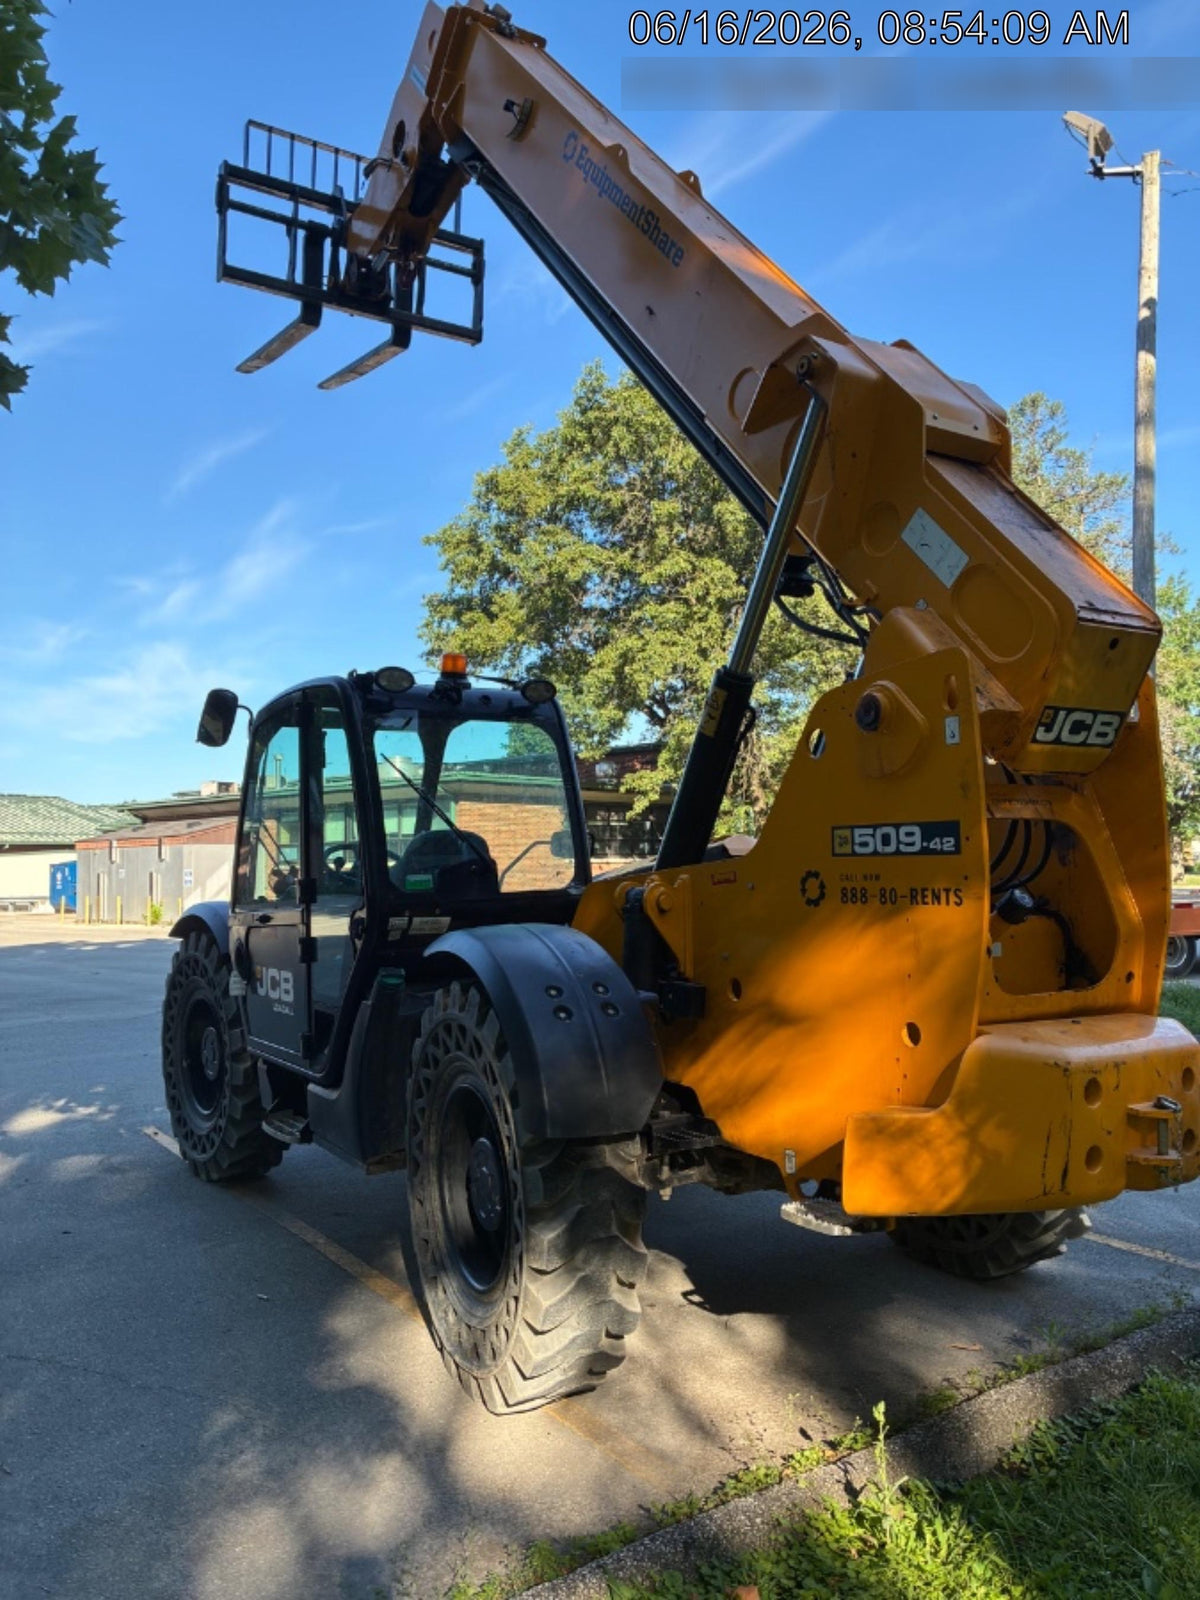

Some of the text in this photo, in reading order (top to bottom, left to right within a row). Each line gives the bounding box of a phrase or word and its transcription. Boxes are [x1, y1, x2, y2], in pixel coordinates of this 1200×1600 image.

[575, 143, 684, 268] EquipmentShare
[1035, 709, 1121, 746] JCB
[853, 824, 957, 854] 509-42
[840, 886, 964, 907] 888-80-RENTS
[256, 966, 294, 1003] JCB
